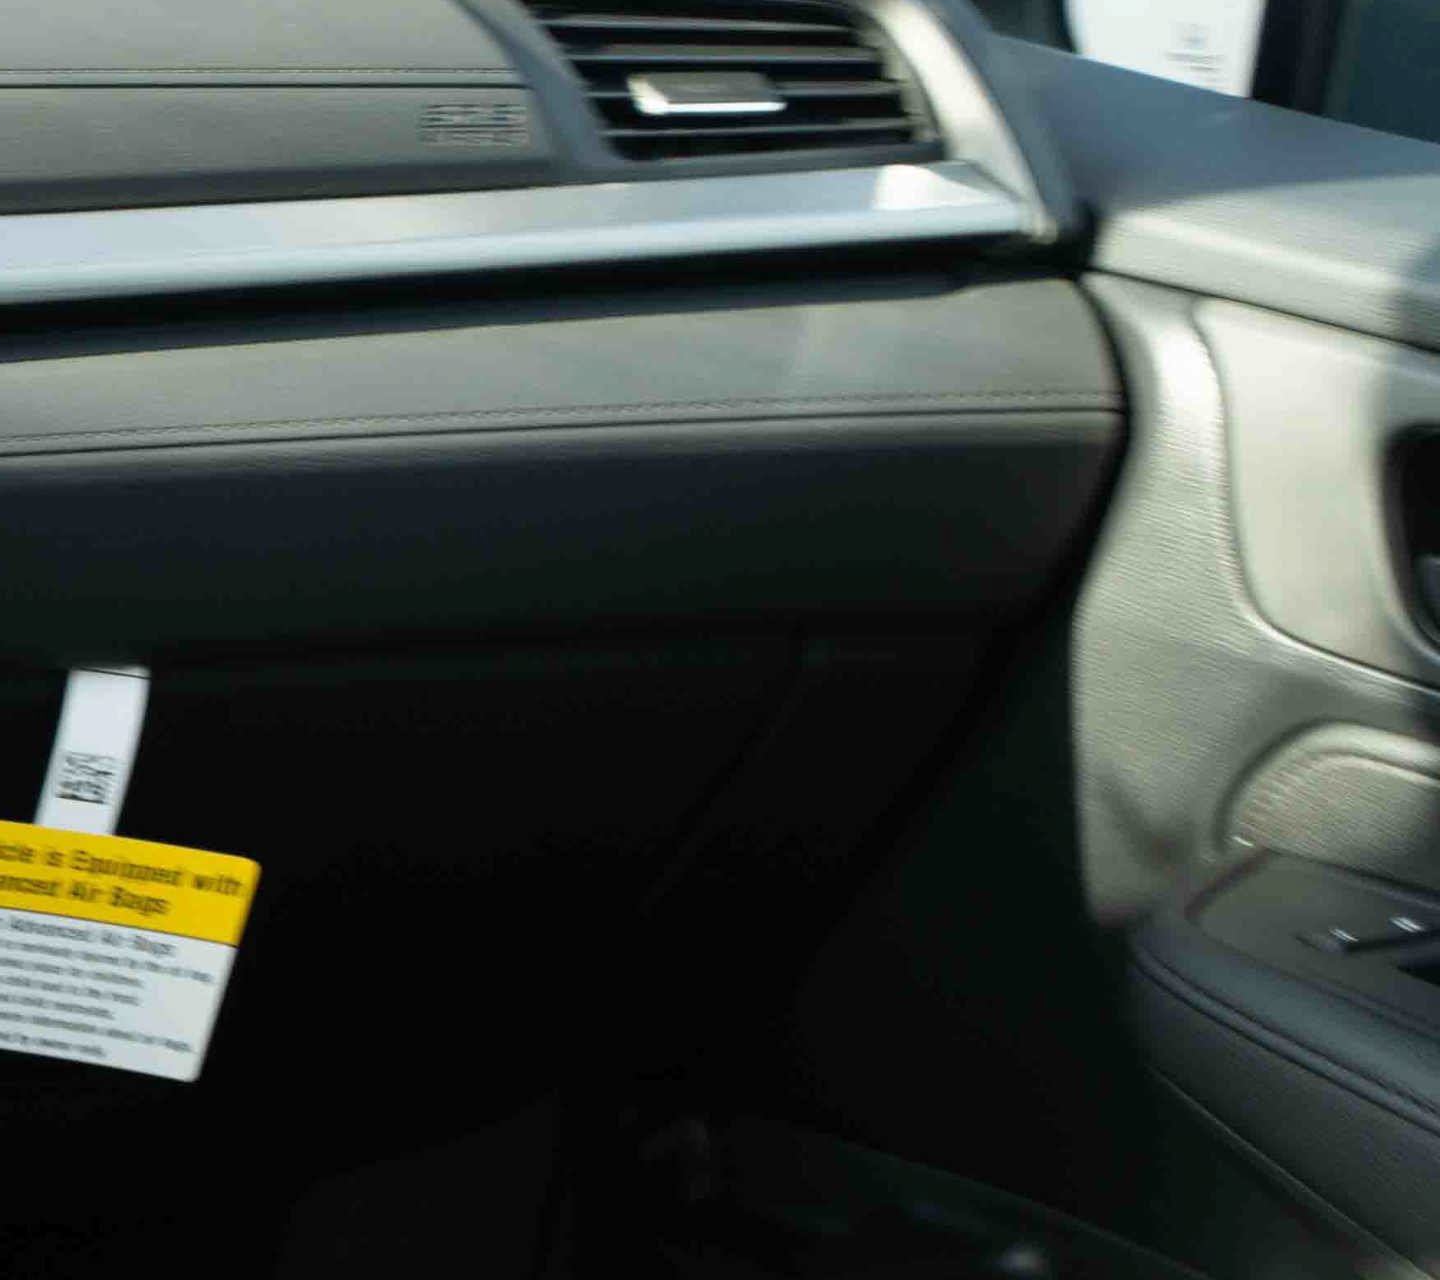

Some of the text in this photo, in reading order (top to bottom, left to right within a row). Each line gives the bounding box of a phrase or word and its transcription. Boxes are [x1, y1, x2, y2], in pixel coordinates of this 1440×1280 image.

[191, 867, 243, 897] with
[65, 881, 102, 904] Air
[110, 885, 172, 917] Bags
